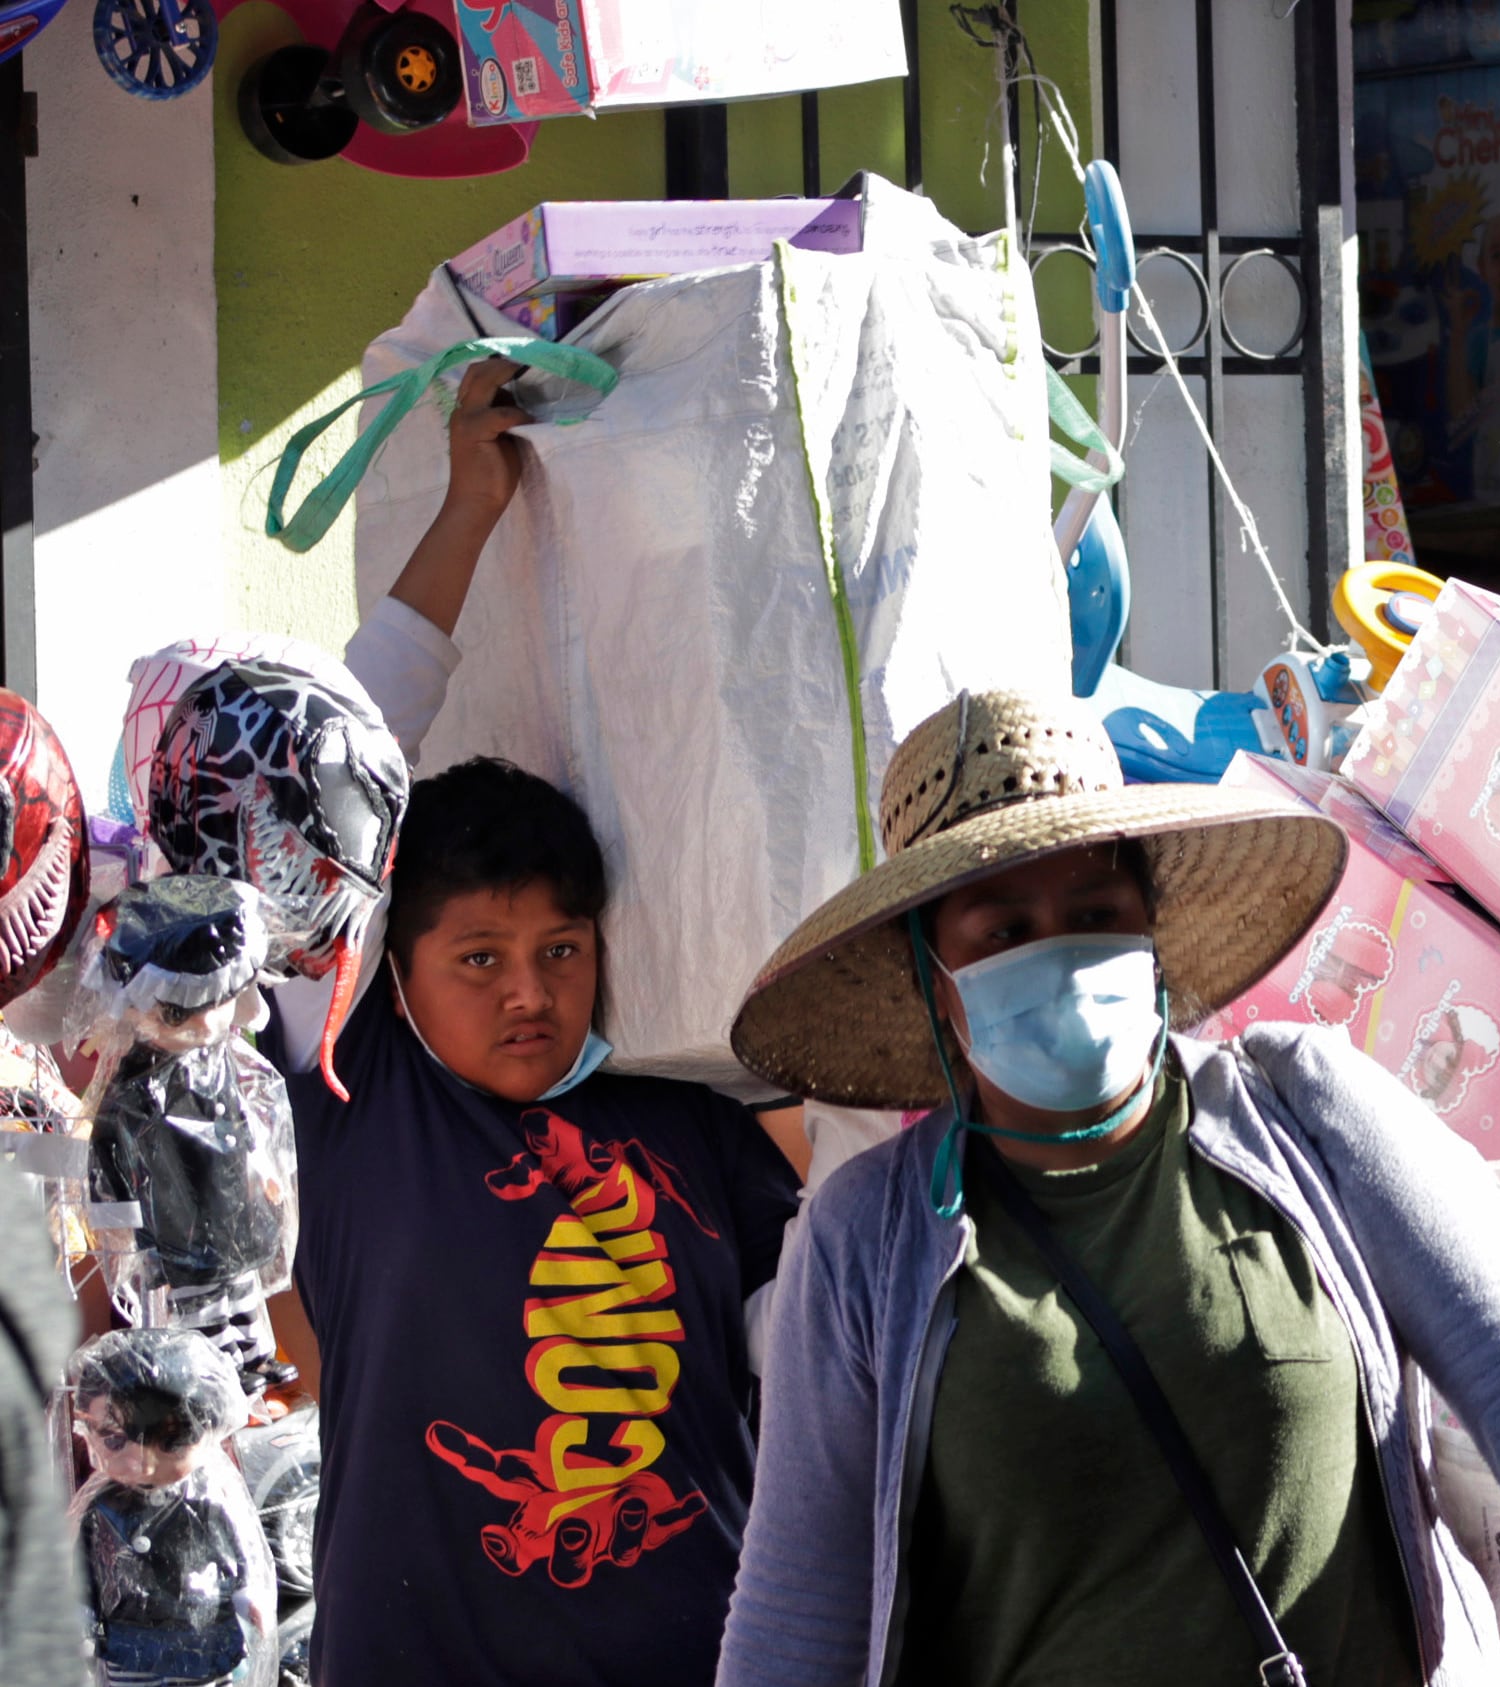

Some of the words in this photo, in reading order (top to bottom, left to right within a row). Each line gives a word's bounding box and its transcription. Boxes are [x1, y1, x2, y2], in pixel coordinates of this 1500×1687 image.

[556, 20, 573, 50] Kids
[487, 63, 501, 111] Kimbo
[562, 53, 578, 88] Safe
[1308, 904, 1354, 973] Vestido
[1288, 966, 1318, 1005] fino
[1419, 977, 1463, 1045] Cabello
[1396, 1040, 1426, 1081] suav
